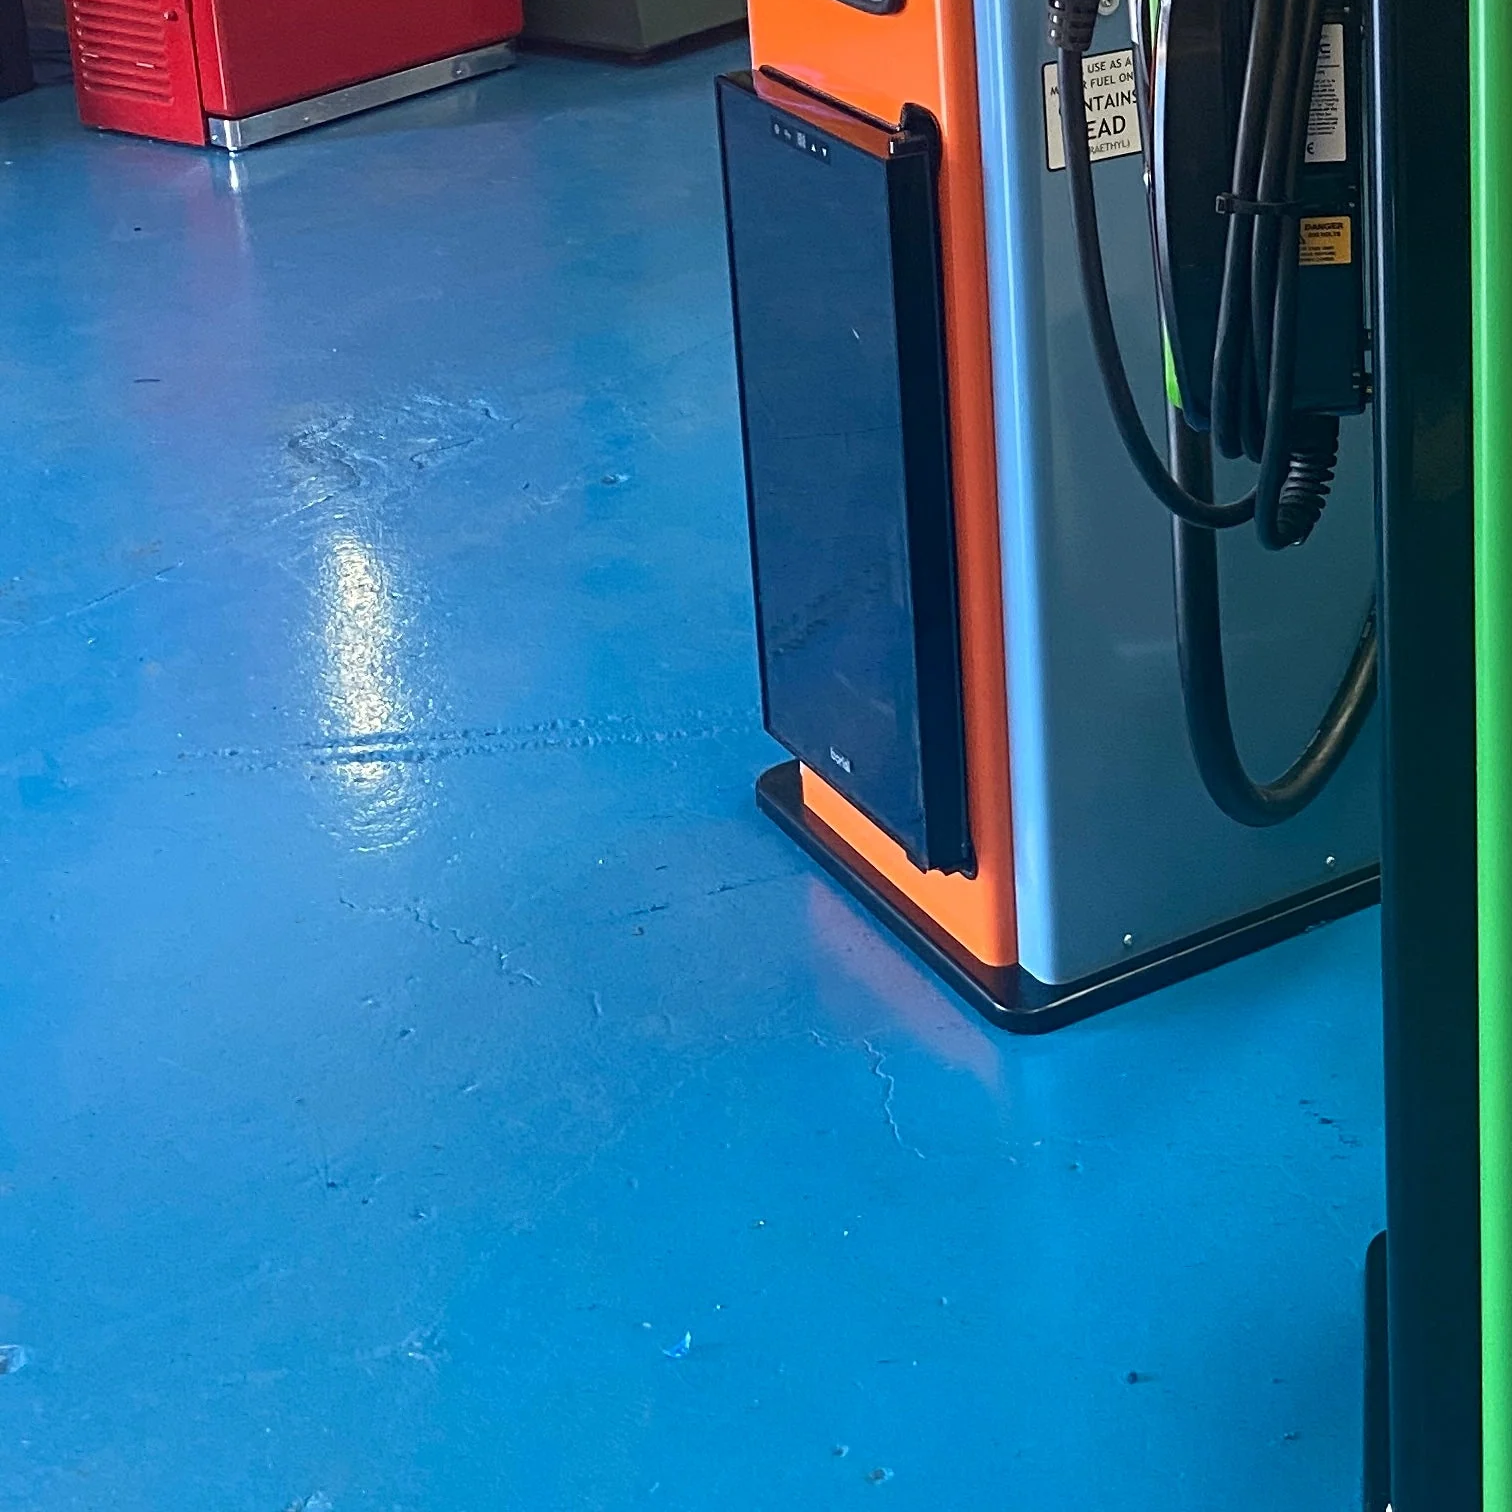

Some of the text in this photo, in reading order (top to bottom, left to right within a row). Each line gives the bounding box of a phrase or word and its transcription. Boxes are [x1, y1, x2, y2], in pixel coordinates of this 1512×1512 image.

[1087, 56, 1133, 74] USE AS A
[1090, 75, 1116, 88] FUEL
[1118, 71, 1134, 84] ON
[1084, 88, 1137, 112] NTAINS
[1087, 115, 1127, 141] EAD
[1304, 222, 1344, 231] DANGER
